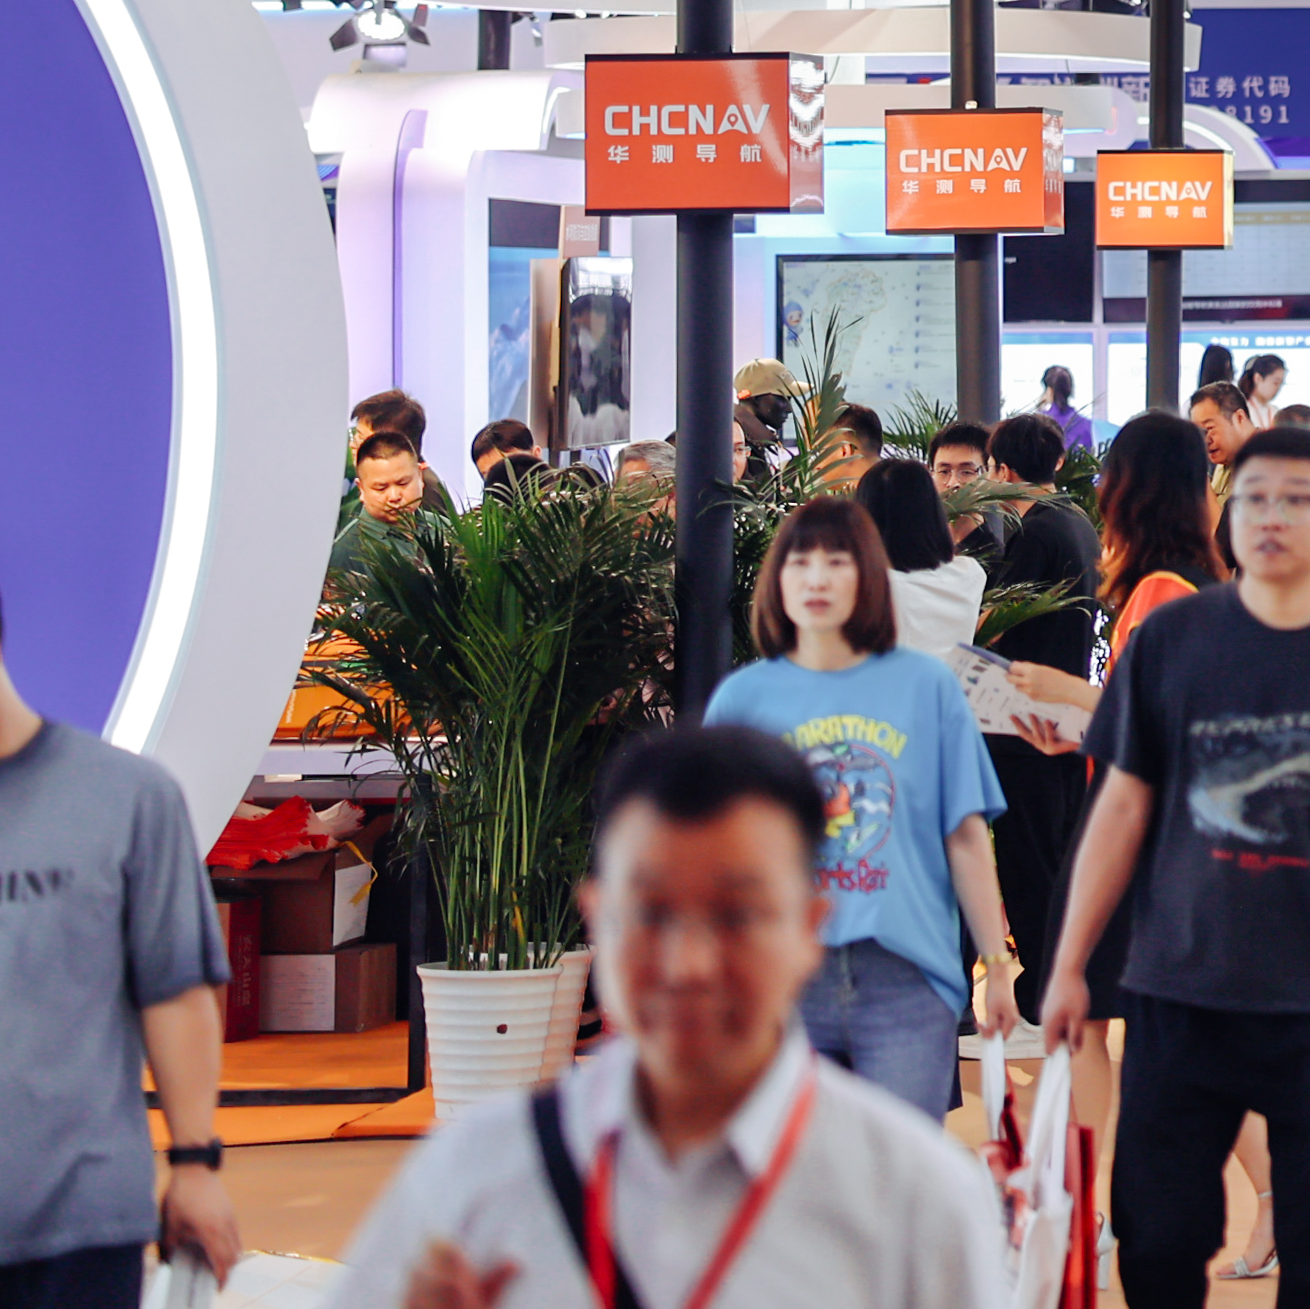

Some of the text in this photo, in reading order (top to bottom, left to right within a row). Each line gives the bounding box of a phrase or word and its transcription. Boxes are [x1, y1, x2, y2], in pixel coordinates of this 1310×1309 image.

[1188, 76, 1292, 99] 证券代码
[604, 104, 770, 136] CHCNAV
[607, 144, 763, 164] 华测导航
[899, 147, 1028, 174] CHCNAV
[902, 178, 1022, 195] 华测导航
[1107, 180, 1213, 202] CHCNAV
[1110, 205, 1208, 219] 华测导航
